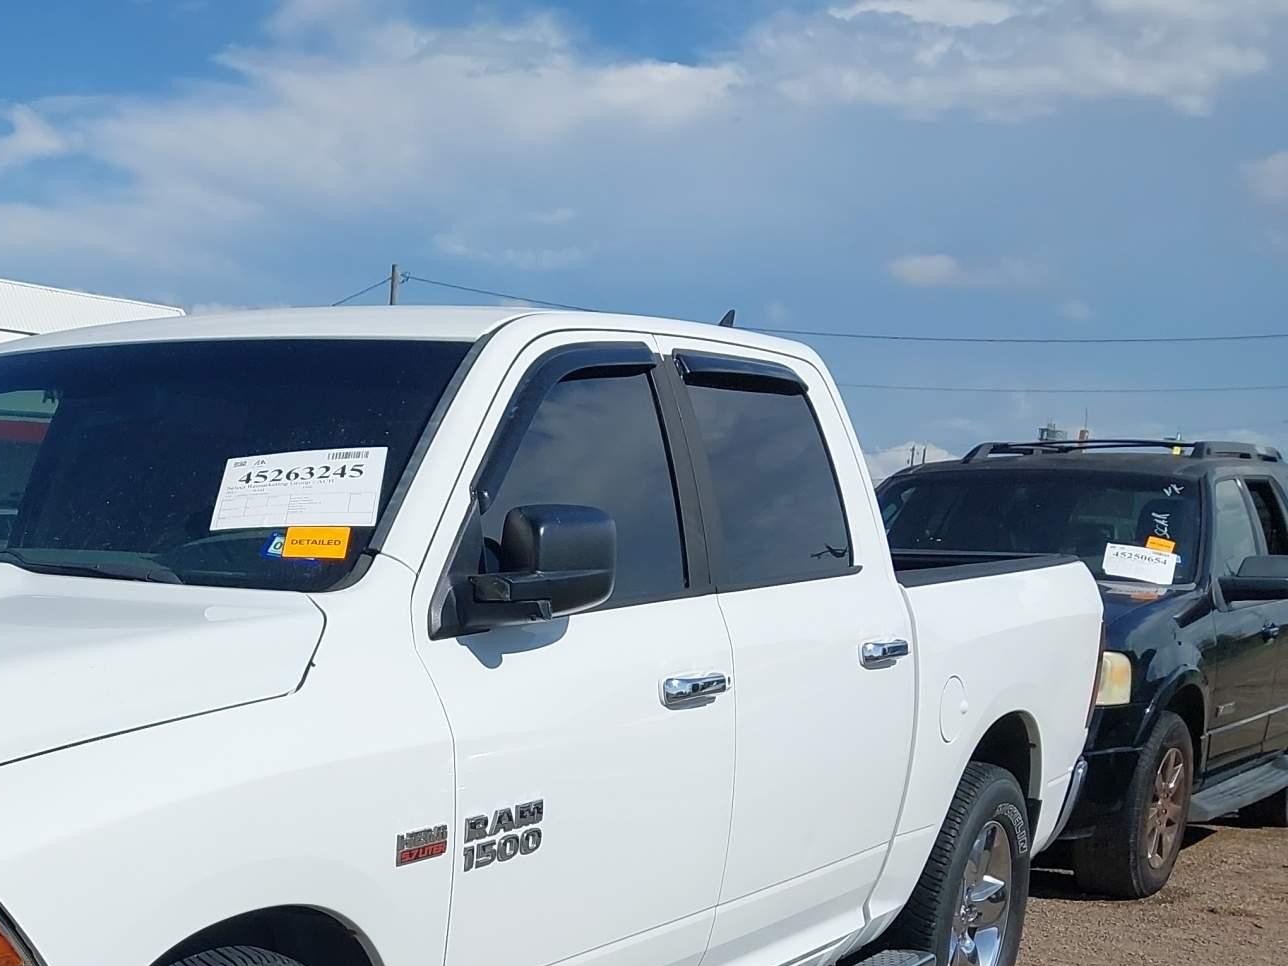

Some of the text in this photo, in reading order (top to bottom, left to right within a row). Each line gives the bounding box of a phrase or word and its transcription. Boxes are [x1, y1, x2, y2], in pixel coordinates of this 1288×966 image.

[238, 463, 365, 484] 45263245
[290, 538, 342, 546] DETAILED
[464, 799, 544, 843] RAM
[397, 824, 448, 850] HEMI
[419, 843, 446, 859] LITER
[463, 827, 543, 872] 1500
